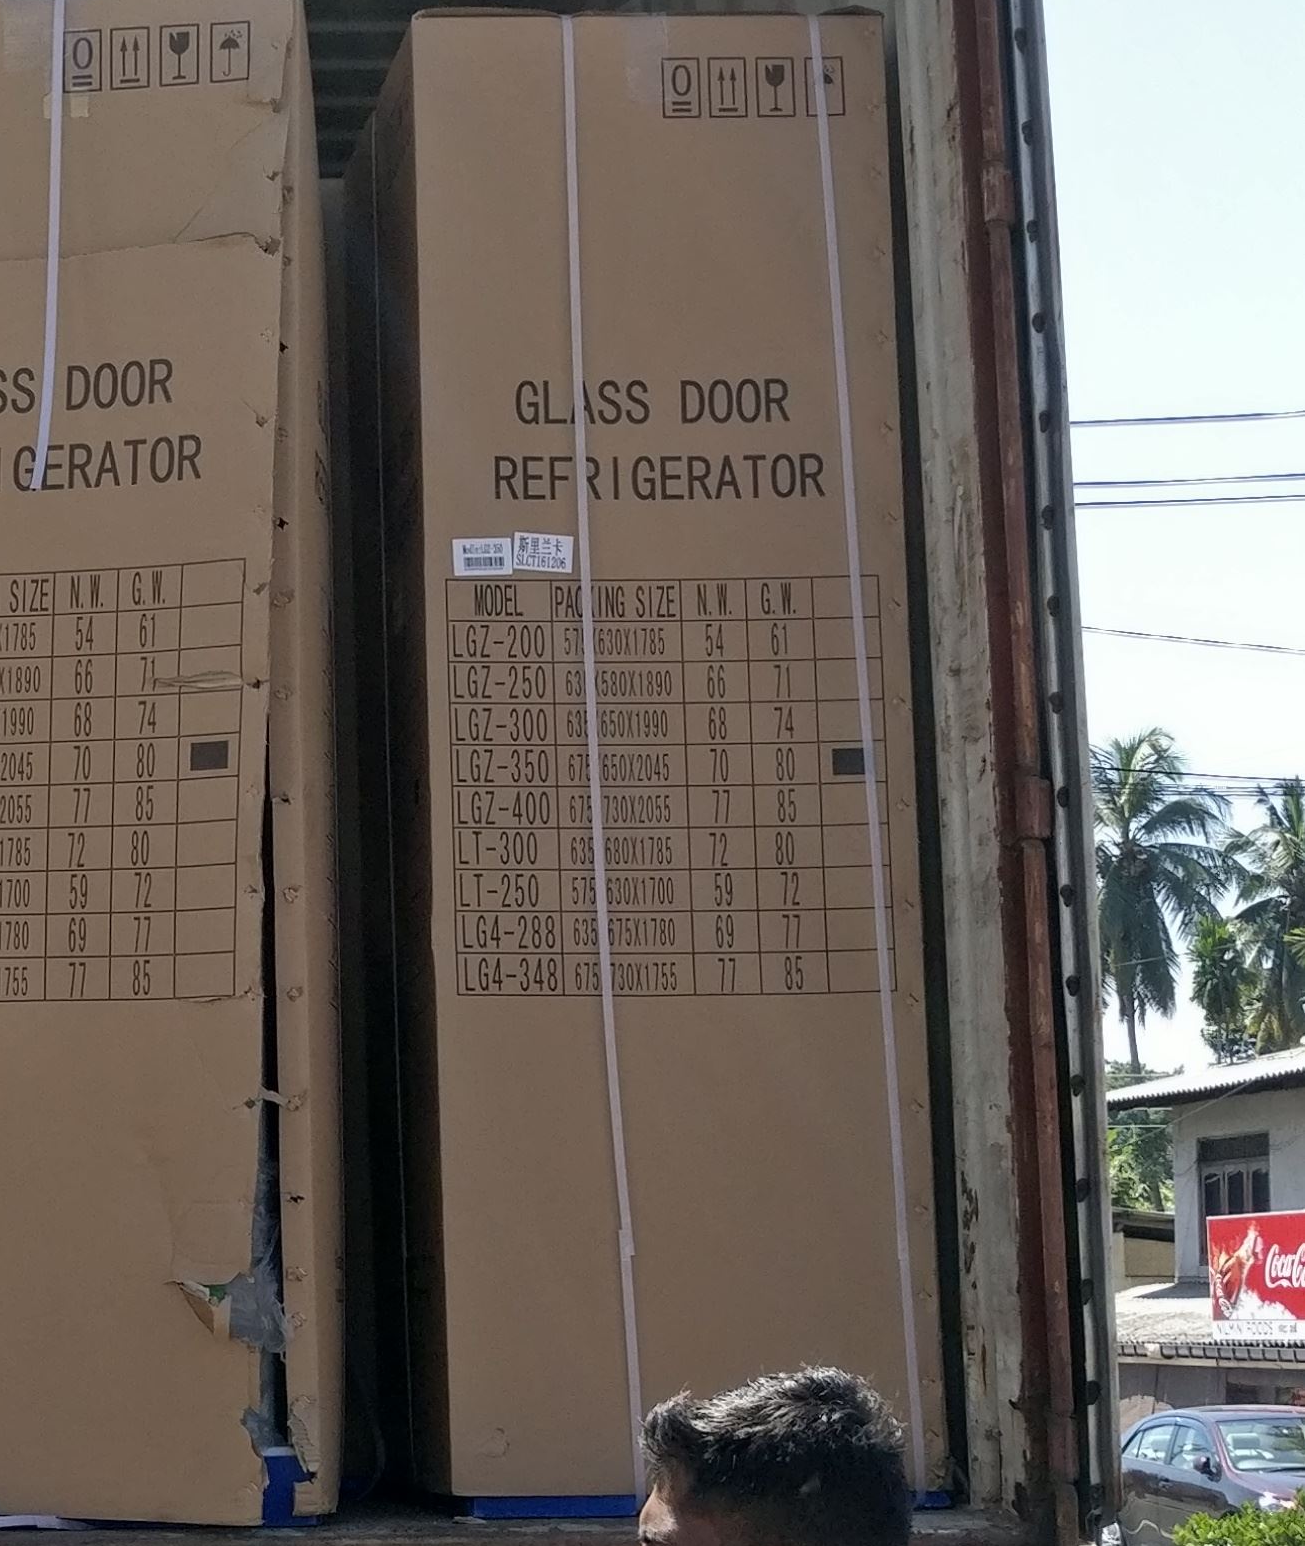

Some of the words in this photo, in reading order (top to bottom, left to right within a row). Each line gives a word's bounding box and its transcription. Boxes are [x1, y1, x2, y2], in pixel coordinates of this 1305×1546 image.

[66, 358, 173, 411] DOOR
[515, 379, 651, 425] GLASS
[680, 378, 790, 424] DOOR
[495, 452, 826, 501] REFRIGERATOR
[515, 553, 567, 570] SLCT161206
[10, 579, 49, 612] SIZE
[474, 585, 524, 617] MODEL
[636, 586, 676, 618] SIZE
[75, 617, 94, 651] 54
[139, 614, 156, 647] 61
[453, 624, 545, 659] LGZ-200
[705, 624, 724, 656] 54
[771, 624, 789, 656] 61
[74, 659, 93, 693] 66
[140, 656, 156, 692] 71
[453, 665, 547, 699] LGZ-250
[707, 665, 725, 698] 66
[774, 665, 790, 698] 71
[74, 703, 91, 737] 68
[138, 701, 156, 734] 74
[455, 709, 548, 742] LGZ-300
[708, 707, 727, 740] 68
[774, 707, 795, 740] 74
[73, 746, 91, 780] 70
[137, 743, 155, 777] 80
[455, 749, 549, 784] LGZ-350
[568, 753, 670, 782] 675650X2045
[710, 749, 729, 783] 70
[776, 748, 795, 781] 80
[73, 788, 91, 823] 77
[136, 786, 154, 819] 85
[457, 792, 551, 827] LGZ-400
[569, 795, 671, 824] 675730X2055
[712, 790, 731, 823] 77
[777, 790, 796, 823] 85
[68, 833, 85, 867] 72
[131, 832, 150, 866] 80
[459, 832, 537, 865] LT-300
[571, 837, 672, 867] 635680X1785
[709, 833, 729, 866] 72
[775, 832, 795, 865] 80
[69, 875, 88, 909] 59
[134, 872, 152, 906] 72
[460, 874, 539, 908] LT-250
[572, 878, 674, 907] 575630X1700
[714, 873, 733, 907] 59
[780, 872, 800, 905] 72
[68, 918, 86, 952] 69
[133, 916, 151, 950] 77
[461, 915, 556, 950] LG4-288
[573, 919, 676, 948] 635675X1780
[715, 915, 734, 949] 69
[782, 915, 801, 948] 77
[69, 963, 86, 996] 77
[132, 960, 150, 995] 85
[465, 958, 558, 992] LG4-348
[574, 961, 677, 991] 675730X1755
[718, 958, 736, 991] 77
[785, 957, 804, 991] 85
